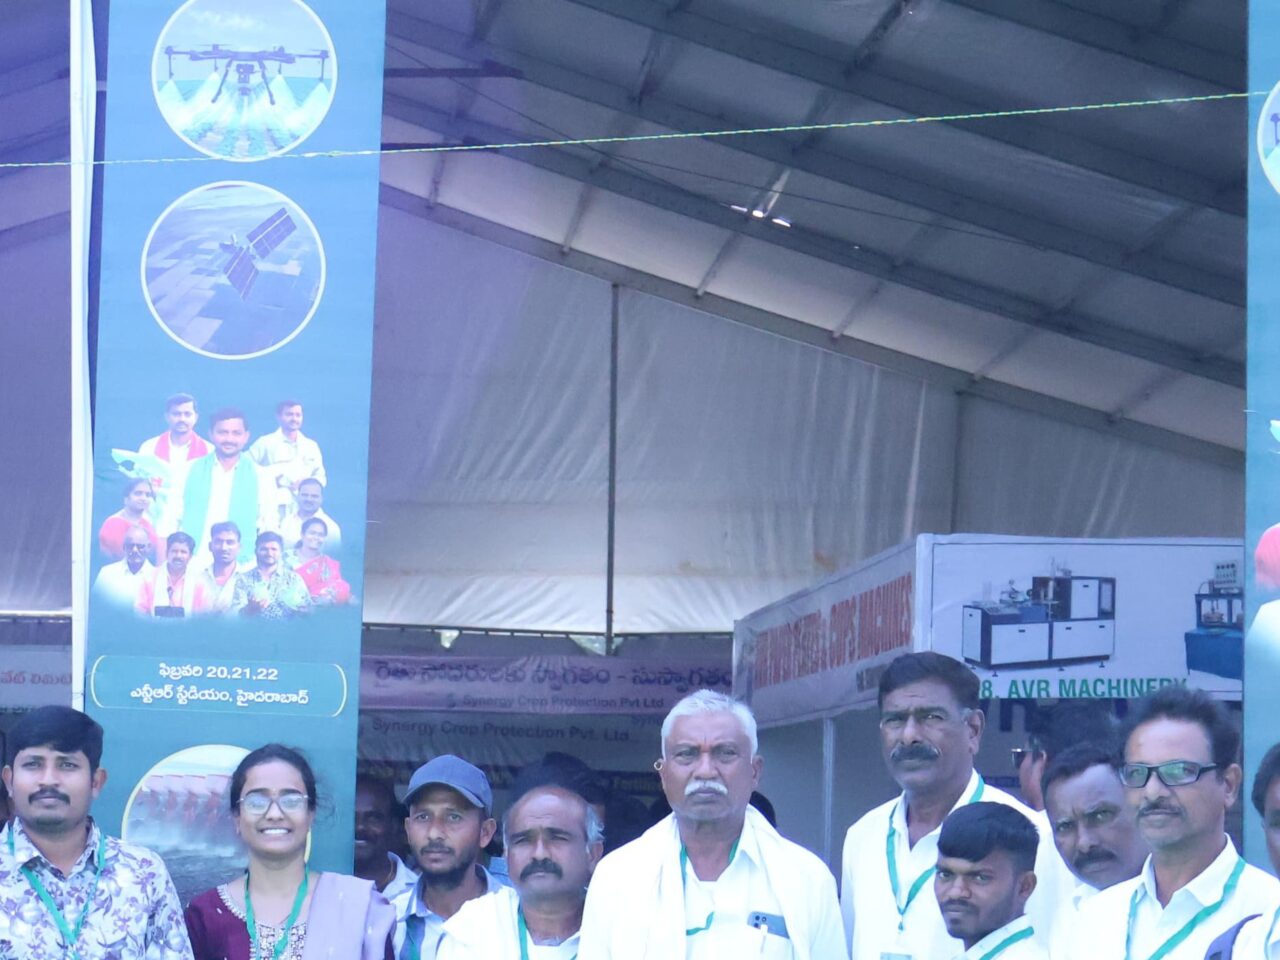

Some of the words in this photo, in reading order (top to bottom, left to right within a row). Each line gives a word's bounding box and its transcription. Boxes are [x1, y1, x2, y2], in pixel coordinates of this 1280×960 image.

[1007, 679, 1051, 699] AVR
[440, 720, 480, 737] Crop
[483, 722, 565, 739] Protection
